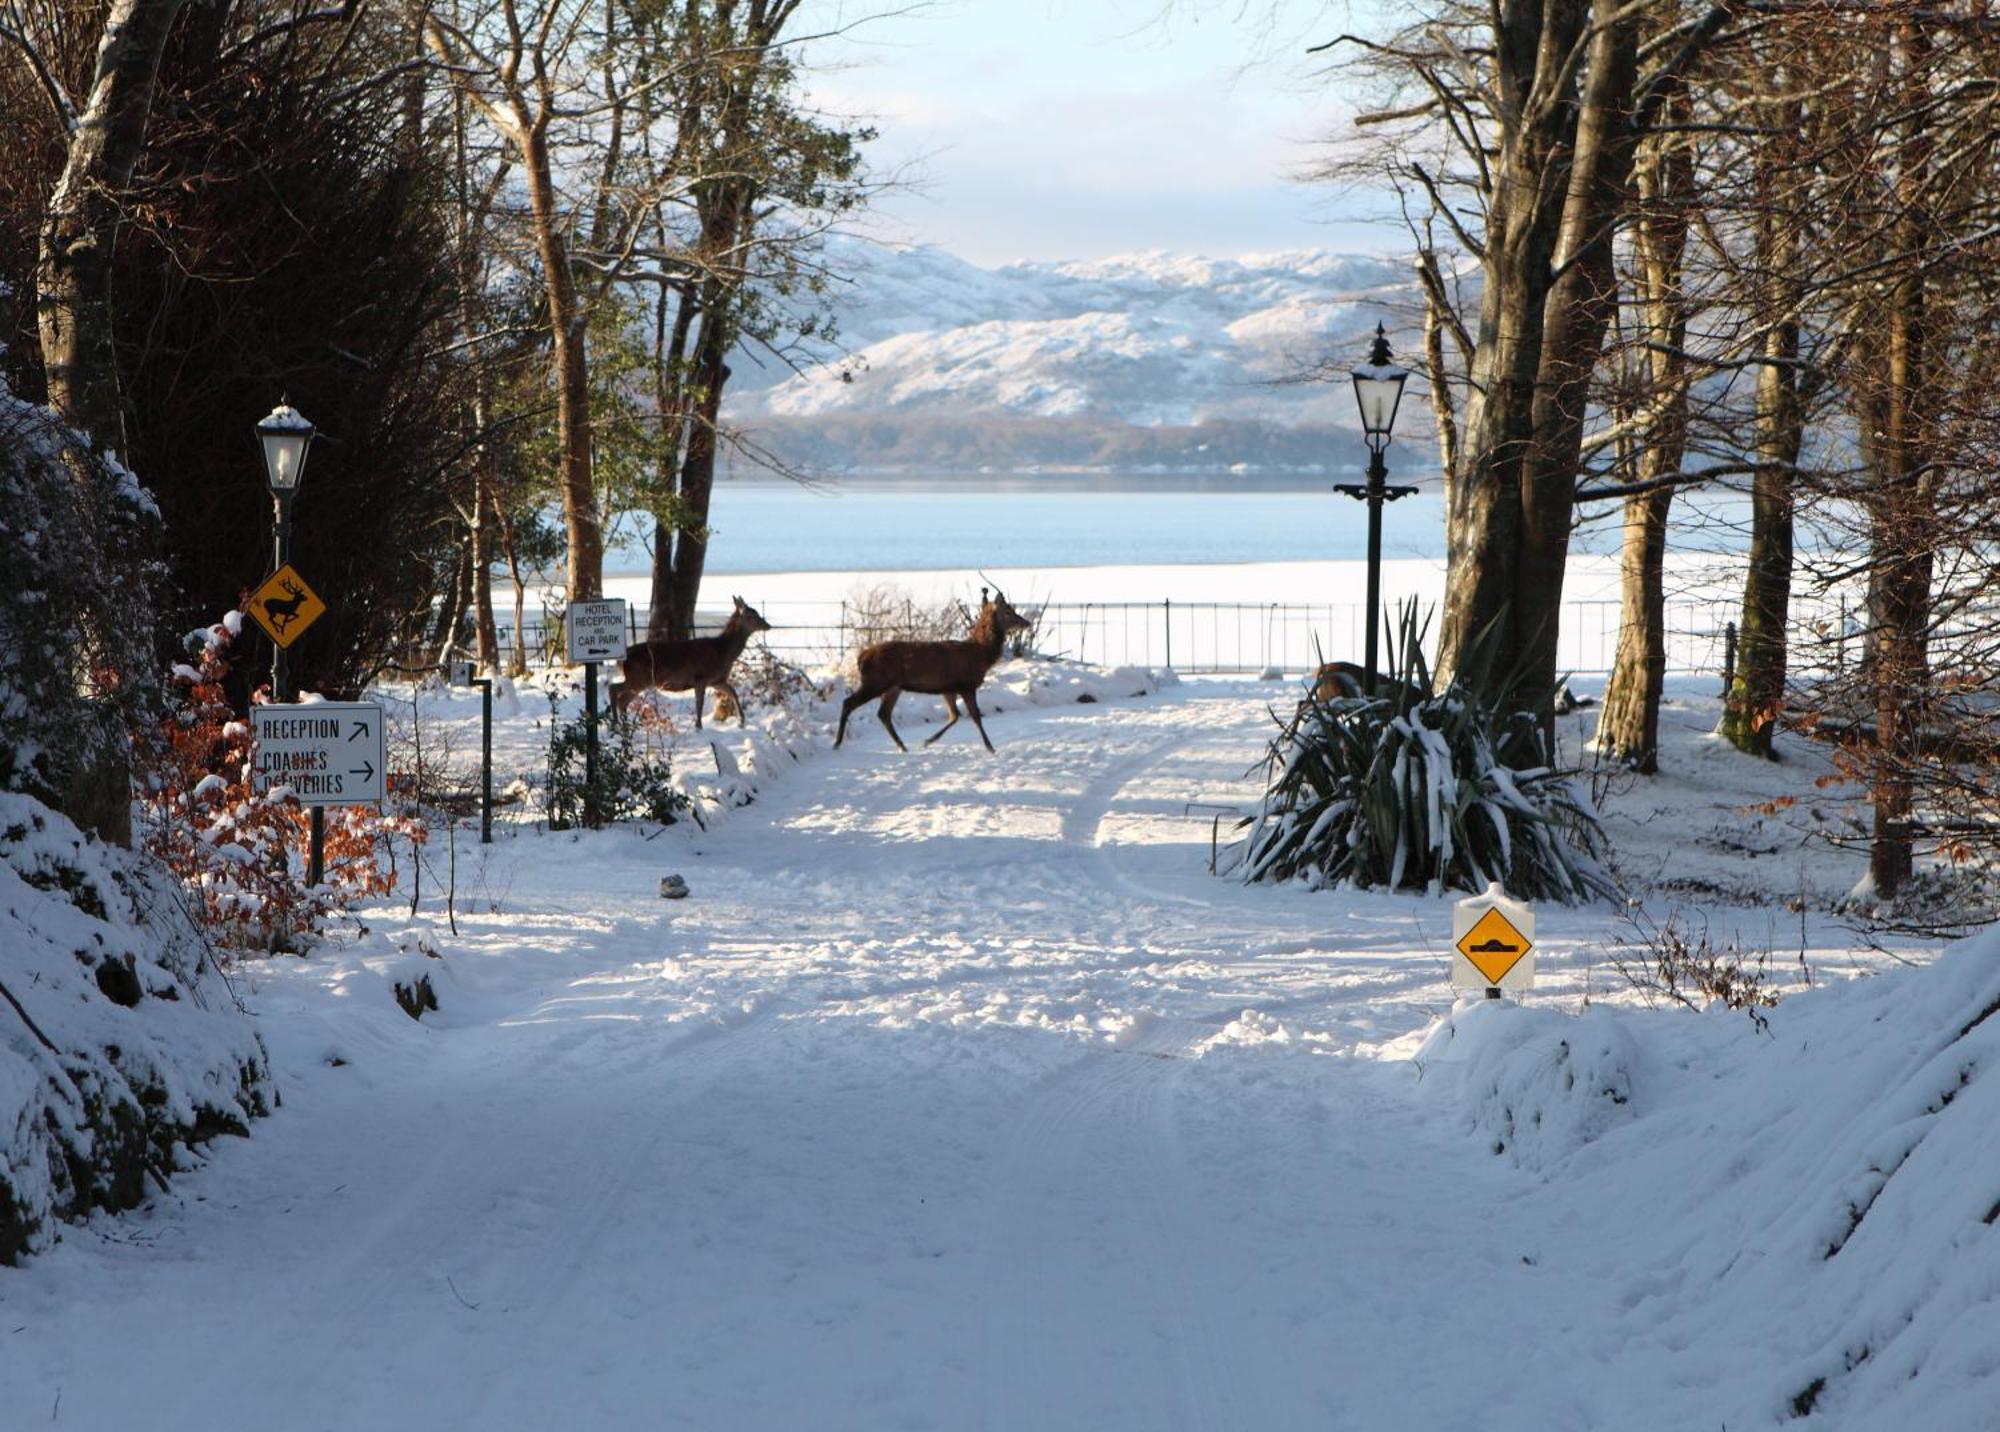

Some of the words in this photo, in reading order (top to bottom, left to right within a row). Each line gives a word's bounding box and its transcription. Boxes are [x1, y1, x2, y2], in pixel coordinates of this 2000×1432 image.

[585, 604, 612, 615] HOTEL
[575, 615, 622, 626] RECEPTION
[578, 636, 596, 646] CAR
[598, 634, 620, 644] PARK
[263, 719, 340, 739] RECEPTION
[264, 775, 343, 794] DVERIES
